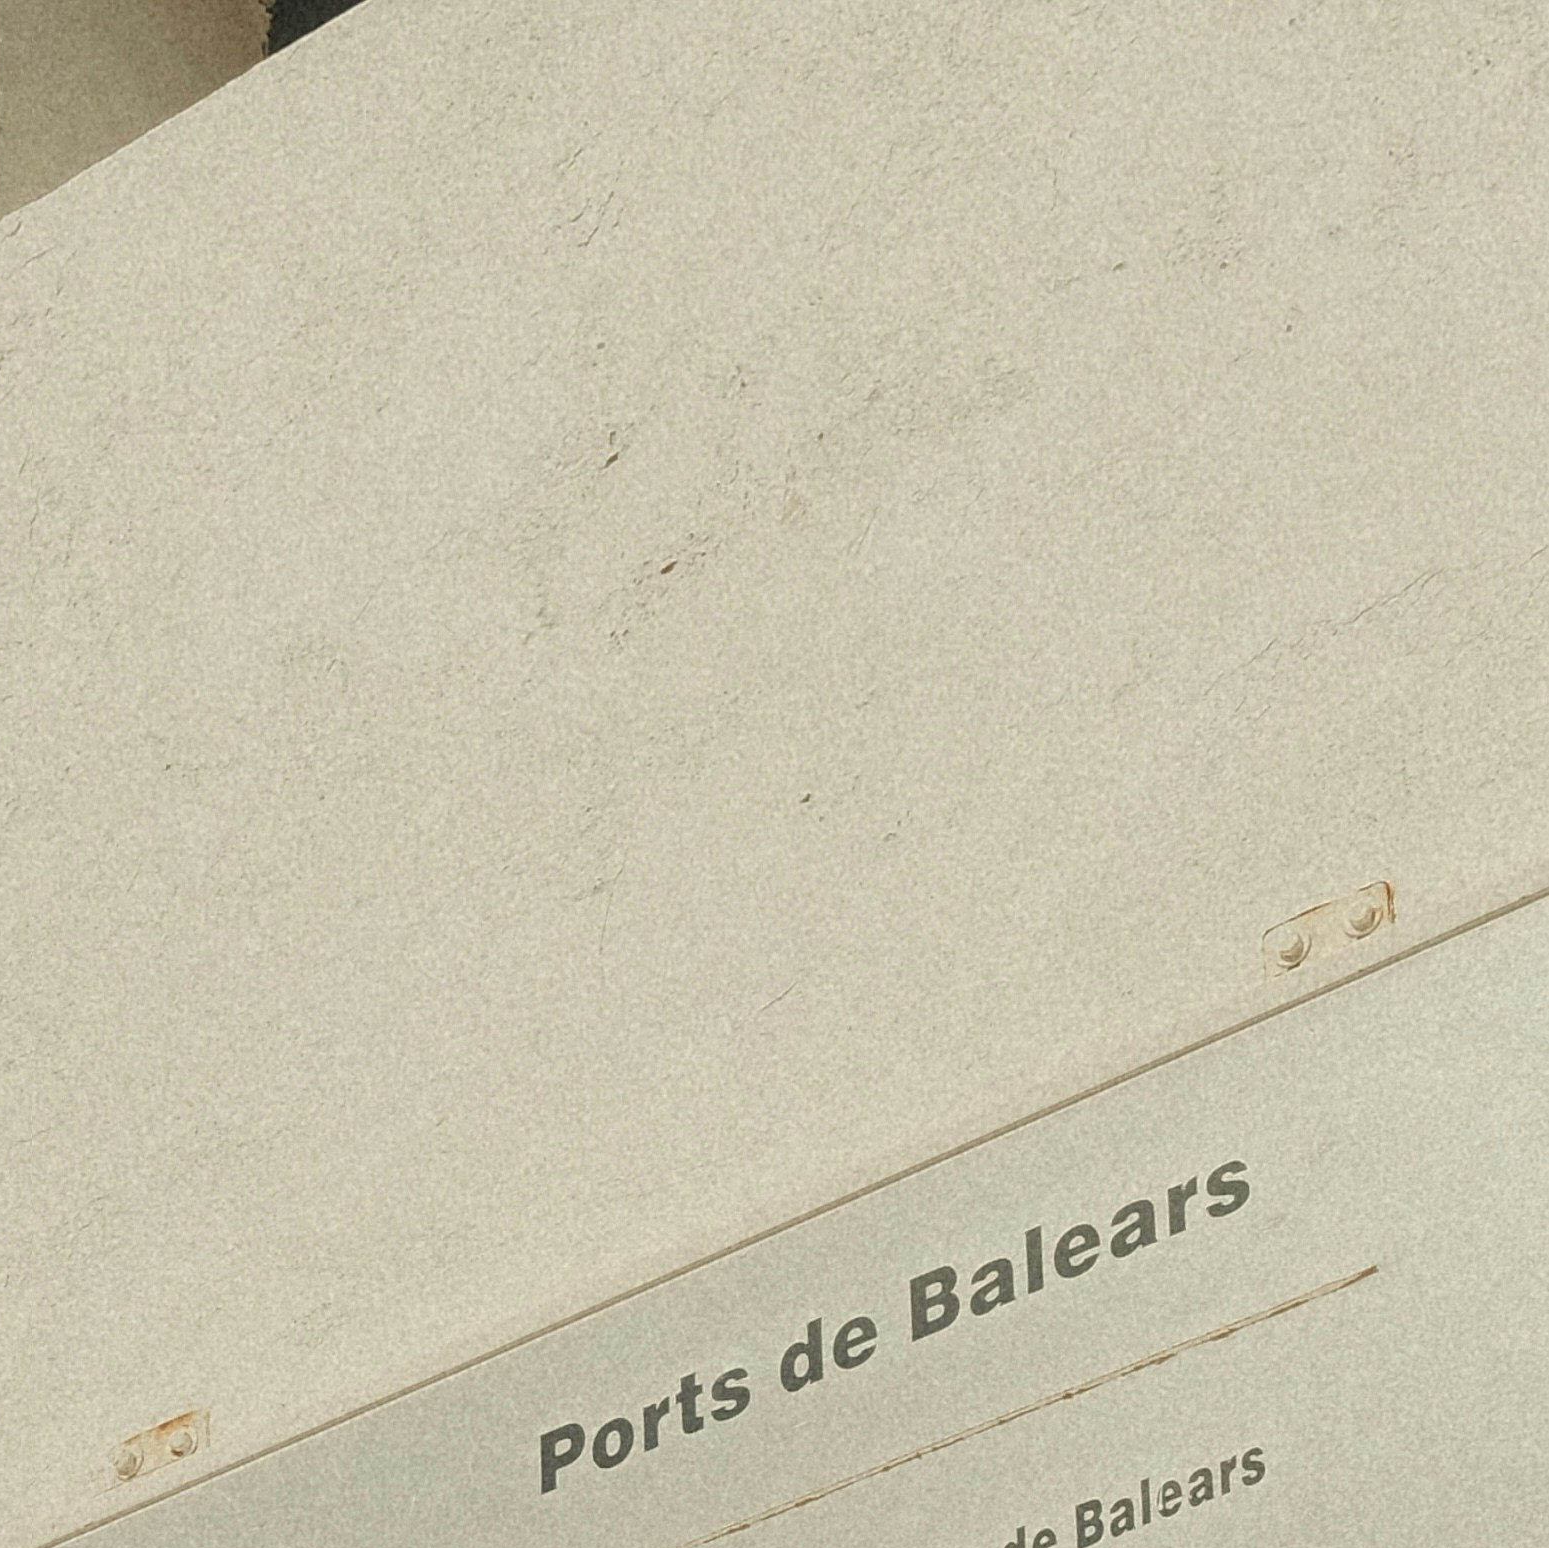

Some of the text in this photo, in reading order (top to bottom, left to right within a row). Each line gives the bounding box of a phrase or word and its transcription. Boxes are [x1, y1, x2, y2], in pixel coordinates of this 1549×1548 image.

[539, 1160, 1250, 1494] Ports de Balears
